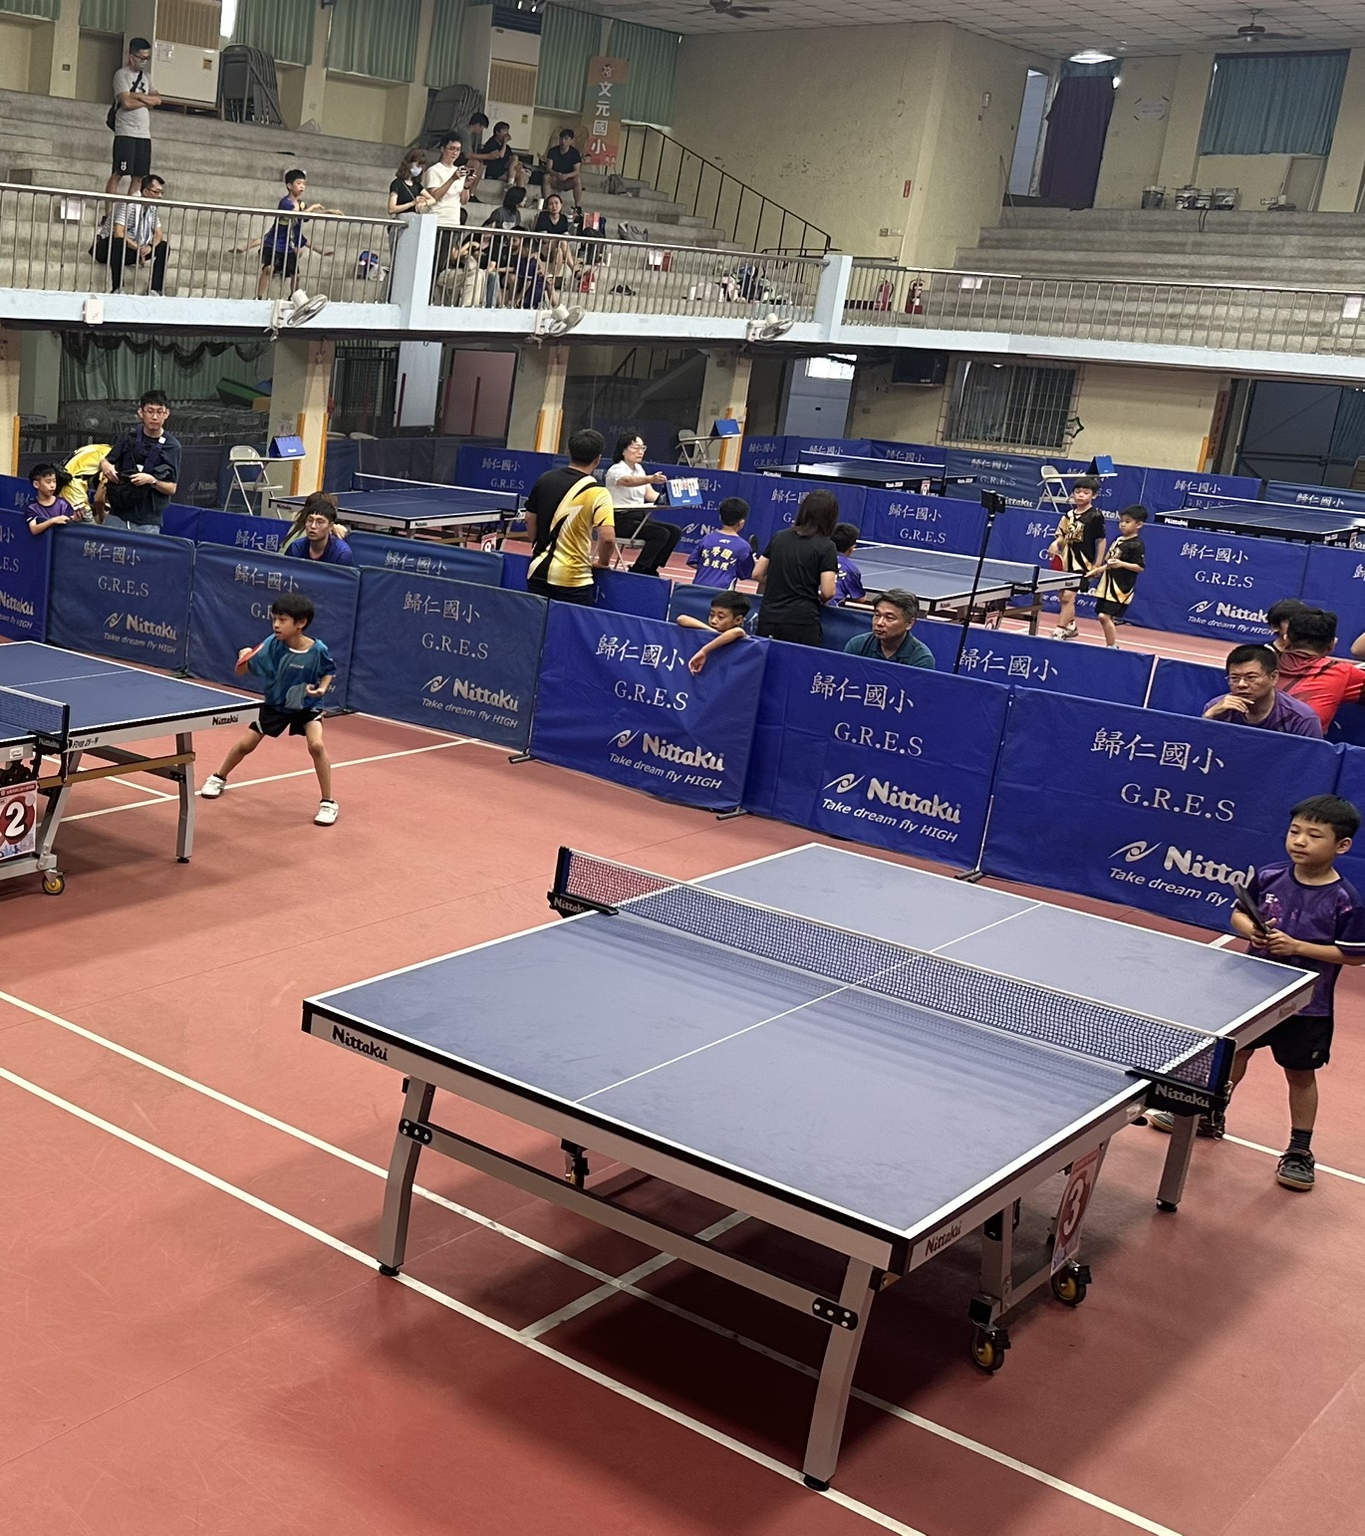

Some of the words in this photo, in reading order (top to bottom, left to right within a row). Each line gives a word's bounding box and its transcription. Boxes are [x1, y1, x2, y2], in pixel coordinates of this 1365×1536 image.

[591, 81, 613, 154] 文元國小
[482, 457, 521, 471] 歸仁國小
[491, 477, 525, 489] G.R.E.S
[1174, 479, 1222, 494] 歸仁國小
[888, 502, 942, 523] 歸仁國小
[1296, 492, 1345, 507] 歸仁國小
[235, 529, 279, 551] 歸仁國
[900, 527, 947, 544] G.R.E.S
[1025, 521, 1055, 541] 歸仁
[83, 540, 141, 566] 歸仁國小
[385, 550, 447, 575] 歸仁國小
[1179, 542, 1249, 565] 歸仁國小
[98, 575, 150, 598] G.R.E.S
[234, 564, 299, 593] 歸仁國小
[1195, 570, 1254, 590] G.R.E.S
[403, 591, 481, 624] 歸仁國小
[126, 613, 177, 640] Nittaku
[1188, 615, 1205, 625] Take
[1208, 617, 1235, 631] dream
[1237, 623, 1248, 634] fly
[103, 631, 120, 643] Take
[122, 635, 146, 647] dream
[148, 639, 157, 651] fly
[158, 641, 176, 654] HIGH
[422, 632, 489, 660] G.R.E.S
[595, 633, 685, 672] 歸仁國小
[959, 646, 1058, 681] 歸仁國小
[453, 678, 520, 712] Nittaku
[614, 680, 689, 711] G.R.E.S
[810, 672, 915, 714] 歸仁國小
[212, 714, 239, 726] Nittaku
[422, 698, 443, 711] Take
[445, 702, 476, 718] dream
[478, 708, 490, 722] fly
[492, 713, 518, 729] HIGH
[643, 734, 725, 772] Nittaku
[835, 721, 923, 758] G.R.E.S
[1091, 727, 1224, 775] 歸仁國小
[608, 751, 632, 767] Take
[633, 758, 665, 776] dream
[666, 769, 681, 782] fly
[684, 773, 722, 789] HIGH
[867, 777, 961, 824] Nittaku
[1120, 782, 1235, 823] G.R.E.S
[5, 801, 25, 837] 2
[822, 797, 850, 815] Take
[852, 805, 896, 828] dream
[899, 816, 918, 835] fly
[919, 823, 958, 844] HIGH
[1164, 845, 1254, 889] Nitta
[1109, 867, 1145, 885] Take
[1149, 878, 1202, 899] dream
[1206, 892, 1228, 907] fly
[554, 896, 584, 912] Nittak
[332, 1024, 388, 1061] Nittaku
[1155, 1083, 1211, 1109] Nittaku
[1063, 1177, 1086, 1235] 3
[924, 1220, 963, 1257] Nittaku
